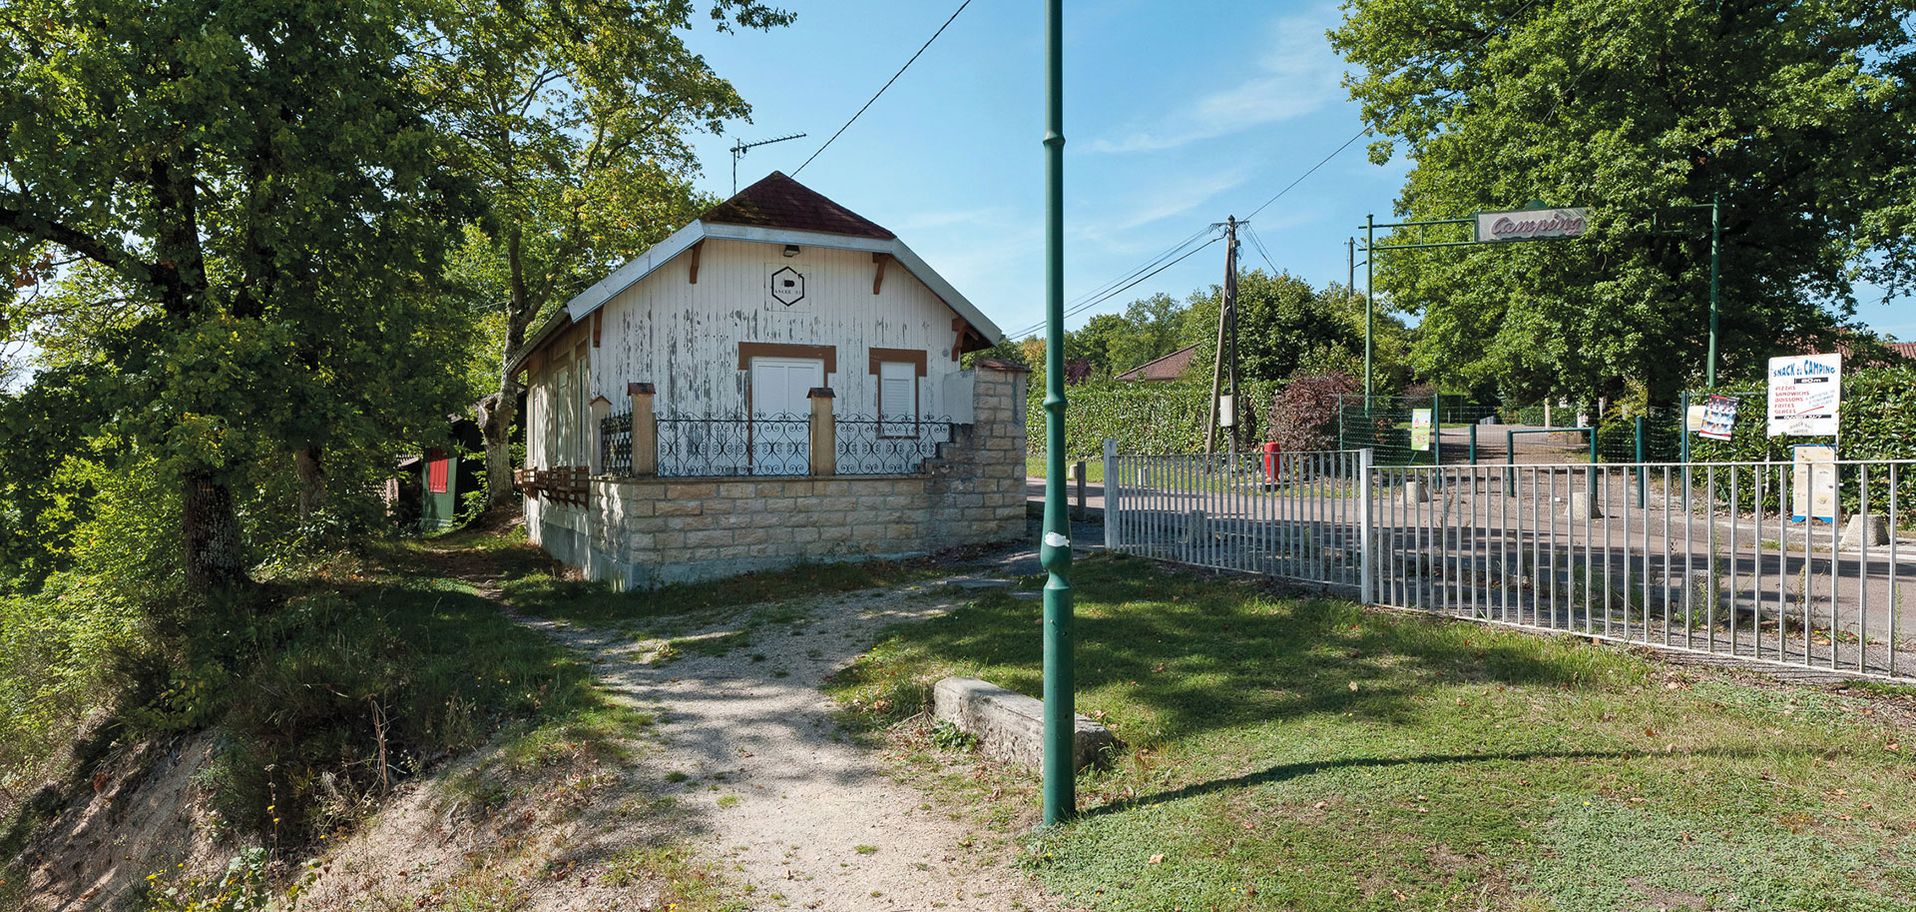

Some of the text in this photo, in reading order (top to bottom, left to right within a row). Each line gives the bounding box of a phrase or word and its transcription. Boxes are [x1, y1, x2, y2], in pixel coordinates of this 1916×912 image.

[1490, 213, 1583, 236] Camping
[1773, 362, 1796, 377] SNACK
[1804, 359, 1836, 376] CAMPING
